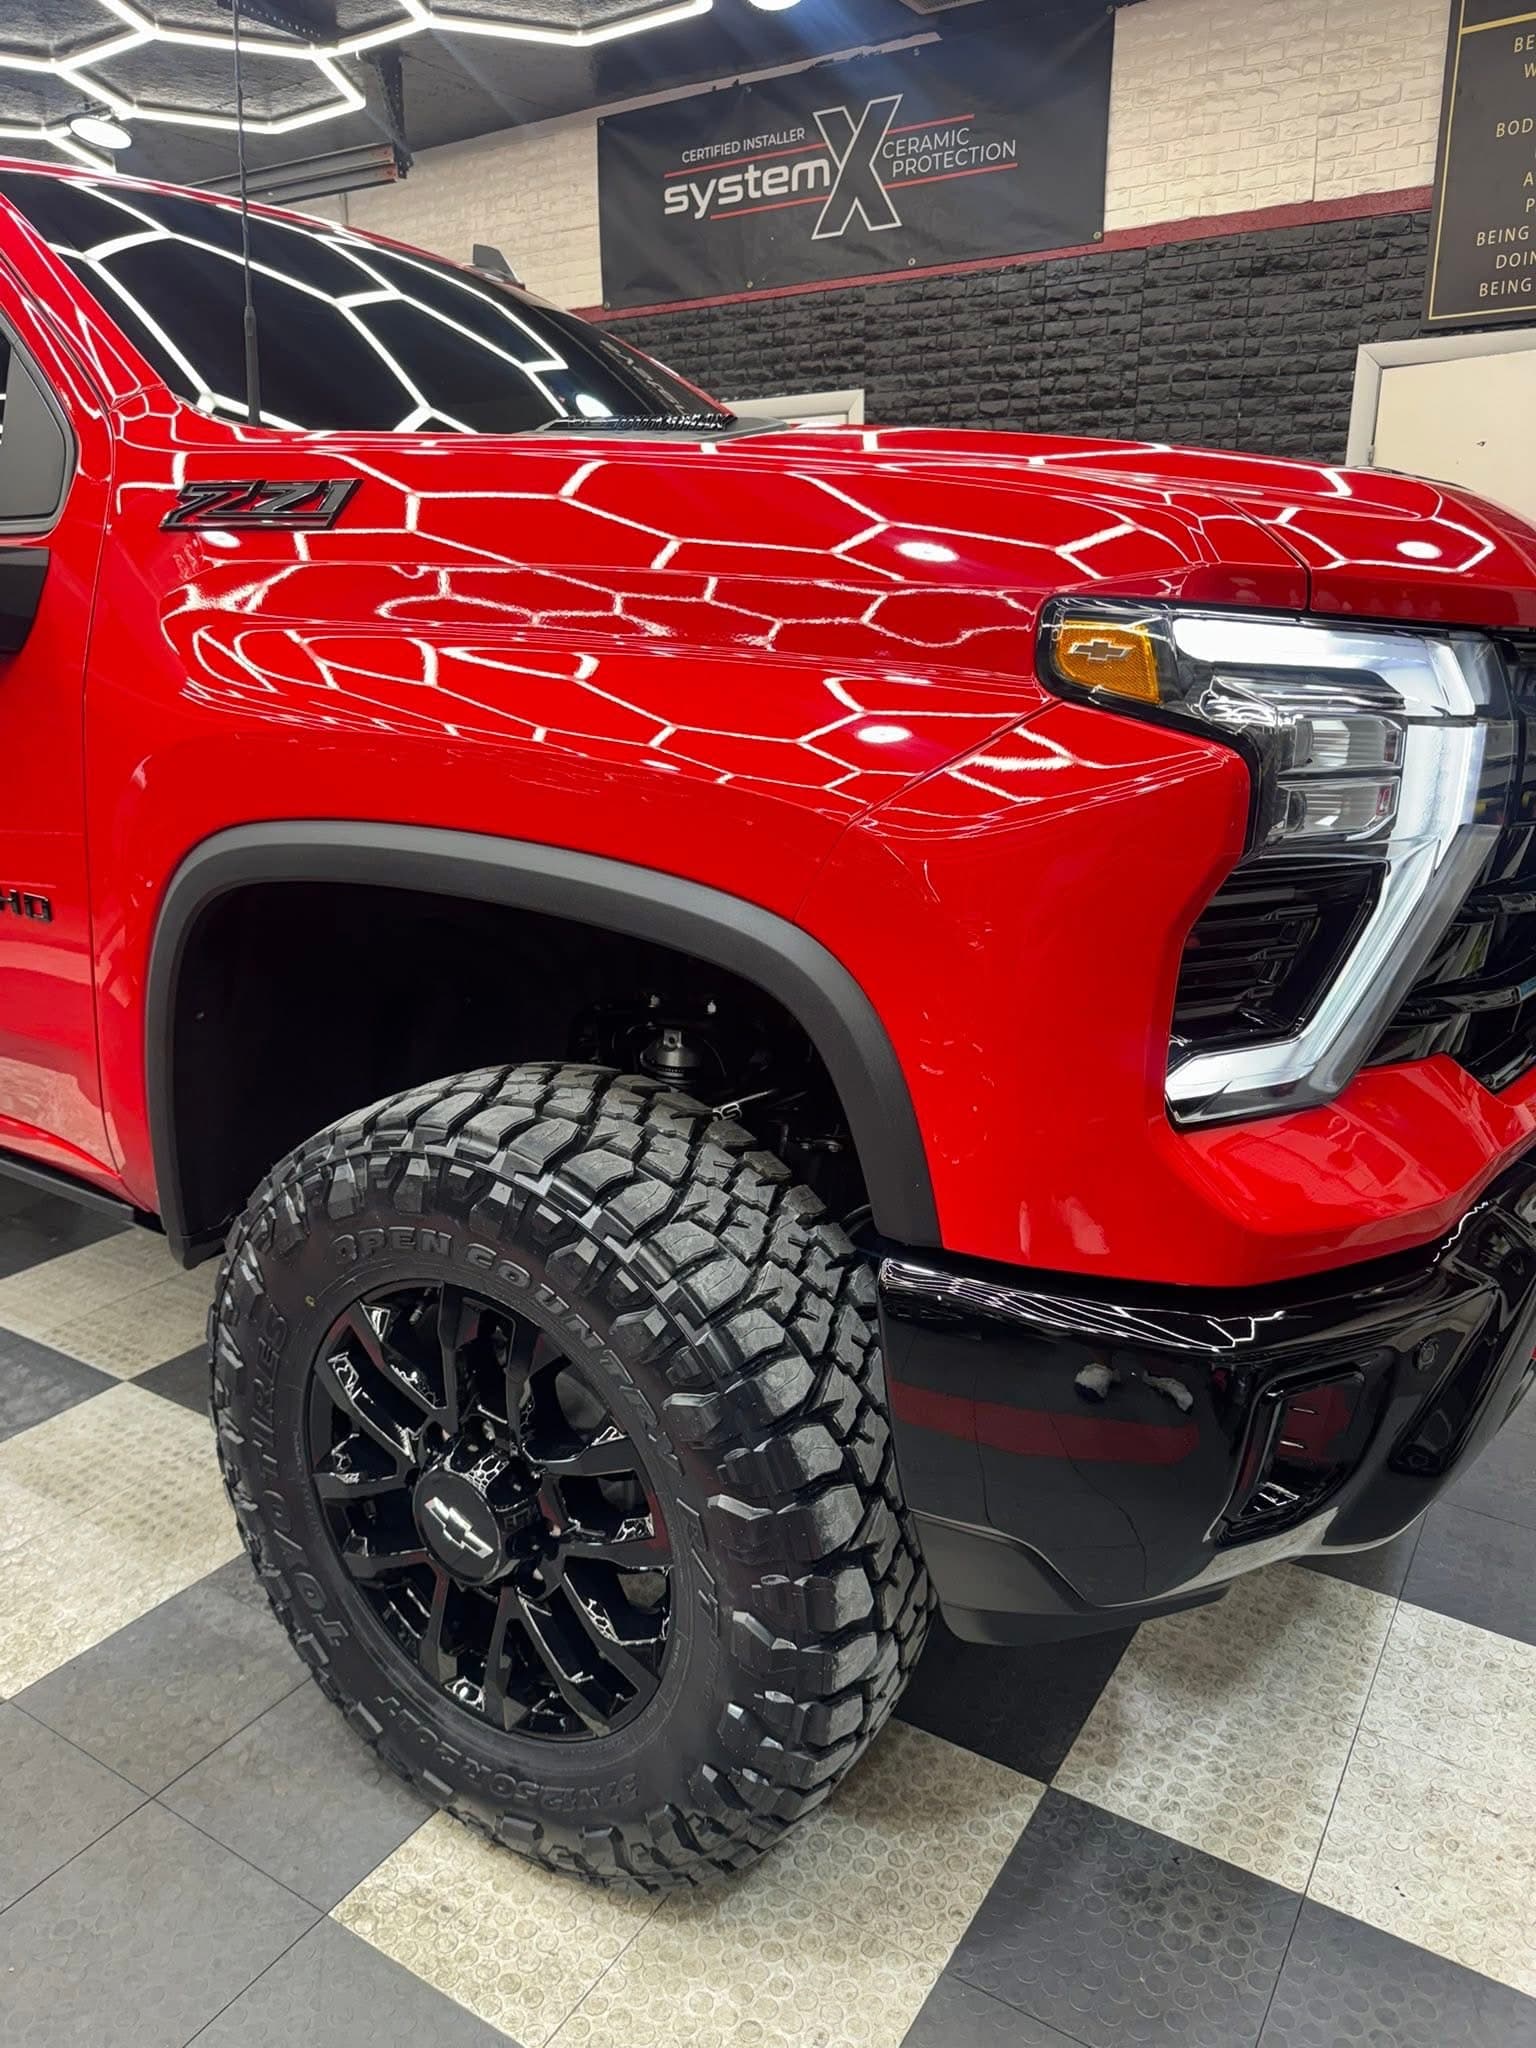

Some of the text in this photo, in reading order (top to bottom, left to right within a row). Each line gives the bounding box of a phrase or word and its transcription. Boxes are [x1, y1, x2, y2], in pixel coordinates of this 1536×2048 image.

[681, 127, 806, 164] CERTIFIED INSTALLER
[882, 126, 970, 161] CERAMIC
[892, 139, 1017, 179] PROTECTION
[663, 93, 903, 240] system X
[1476, 225, 1529, 247] BEING
[1479, 277, 1532, 297] BEING
[159, 479, 364, 531] Z71
[331, 1223, 453, 1264] OPEN
[468, 1238, 686, 1477] COUNTRY
[248, 1303, 349, 1648] TOYO TIRES
